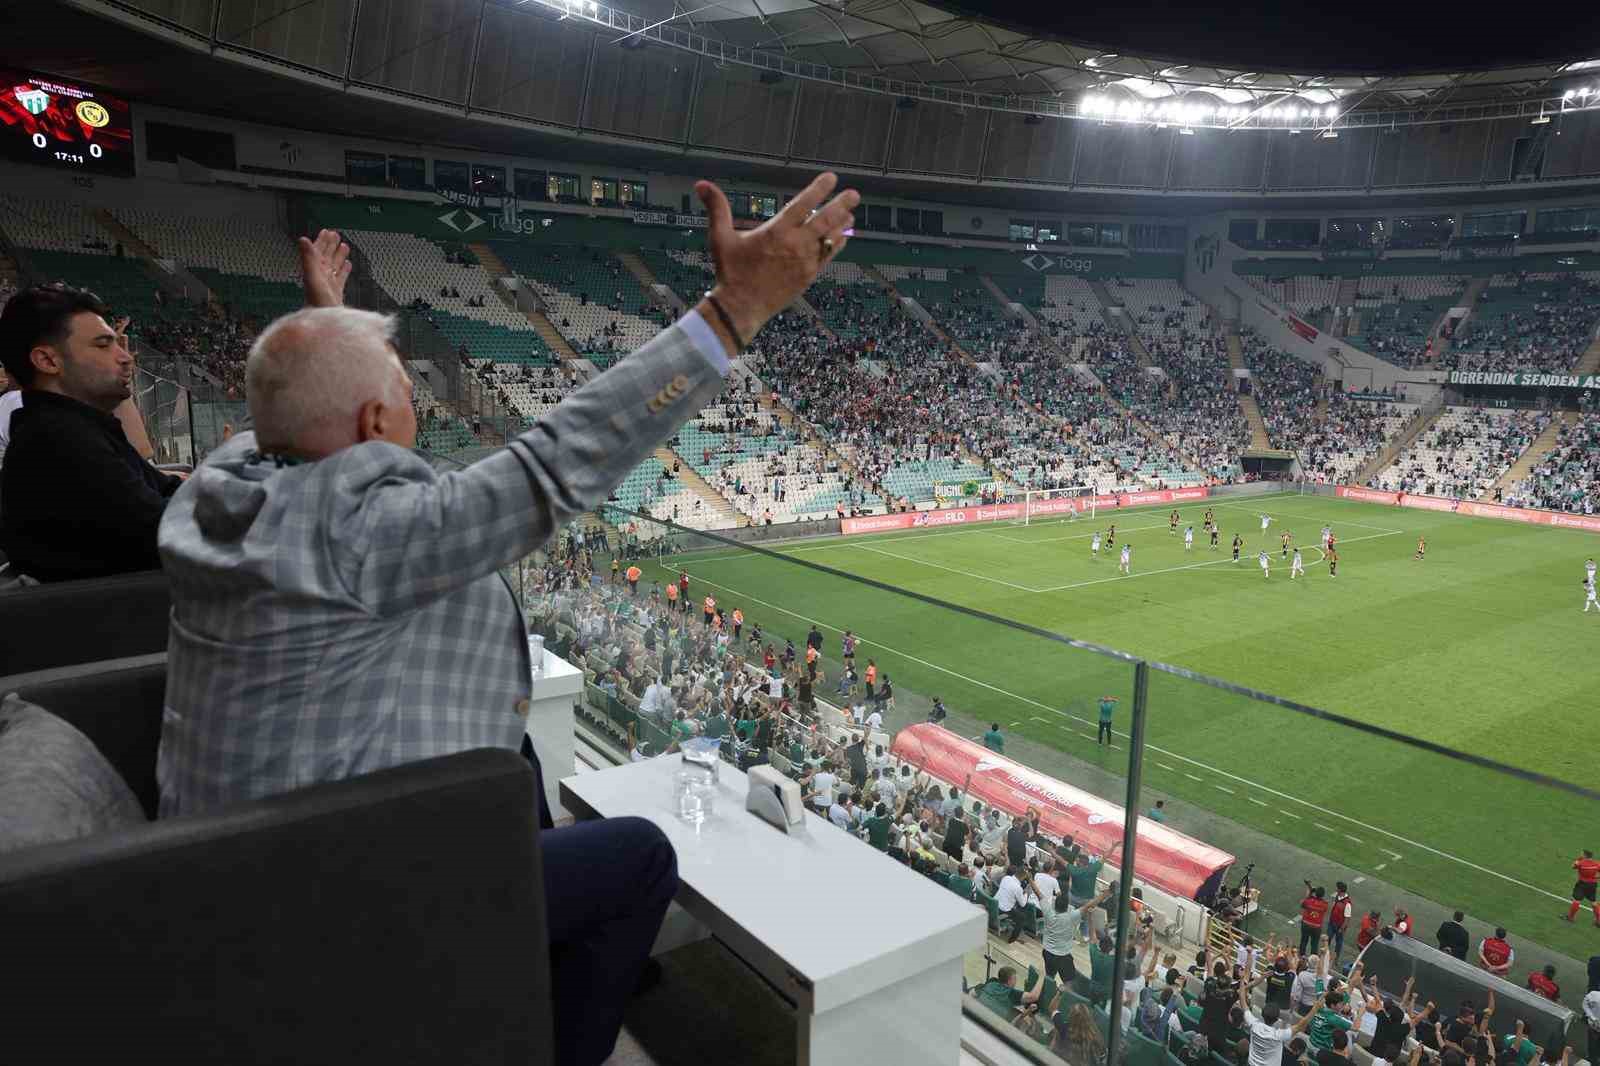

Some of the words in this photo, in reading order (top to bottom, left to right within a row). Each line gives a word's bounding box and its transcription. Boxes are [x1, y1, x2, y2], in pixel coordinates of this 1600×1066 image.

[32, 133, 47, 148] 0
[89, 143, 103, 158] 0
[54, 151, 84, 164] 17:11
[1056, 256, 1092, 271] Togg
[1521, 373, 1579, 387] SENDEN
[1495, 400, 1508, 408] 113
